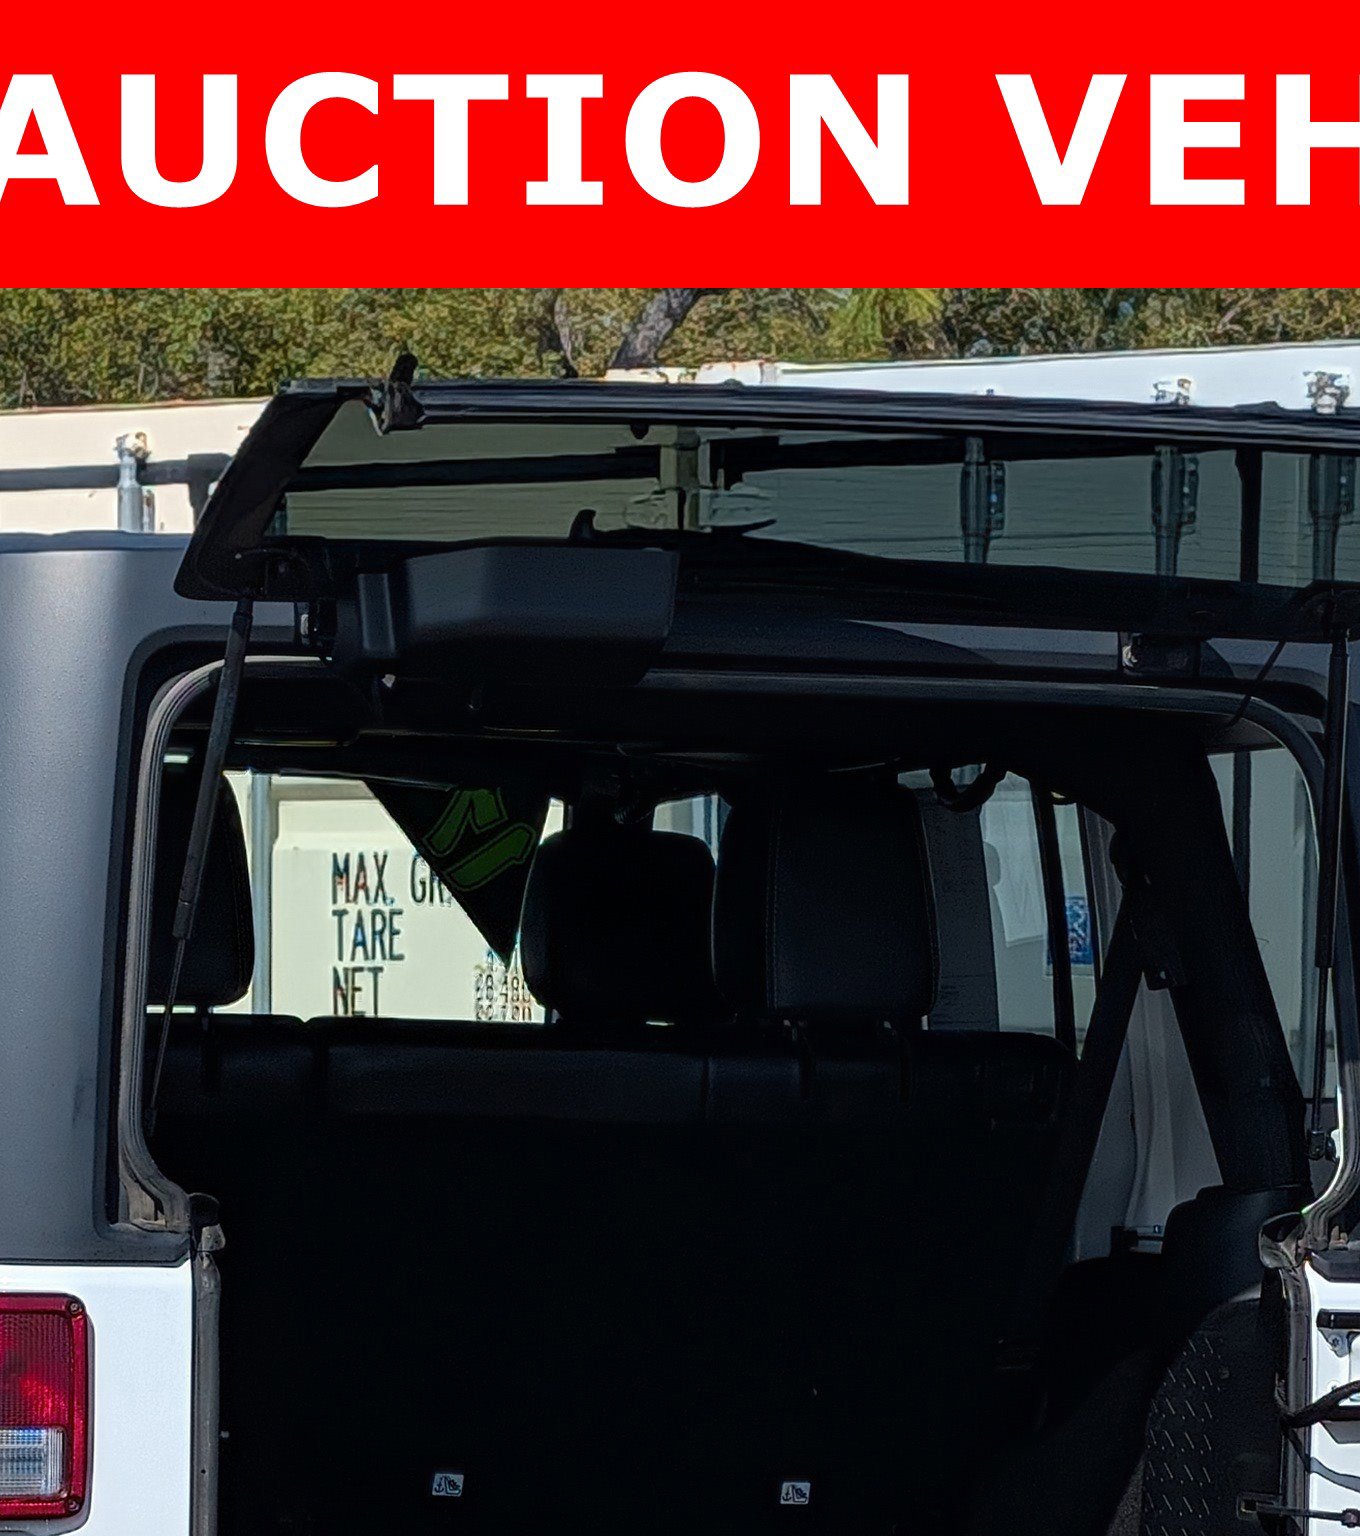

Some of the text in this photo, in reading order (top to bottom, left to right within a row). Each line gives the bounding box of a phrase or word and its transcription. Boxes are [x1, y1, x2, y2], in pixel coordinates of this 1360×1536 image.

[331, 850, 395, 905] MAX.
[331, 909, 405, 961] TARE
[332, 966, 384, 1016] NET
